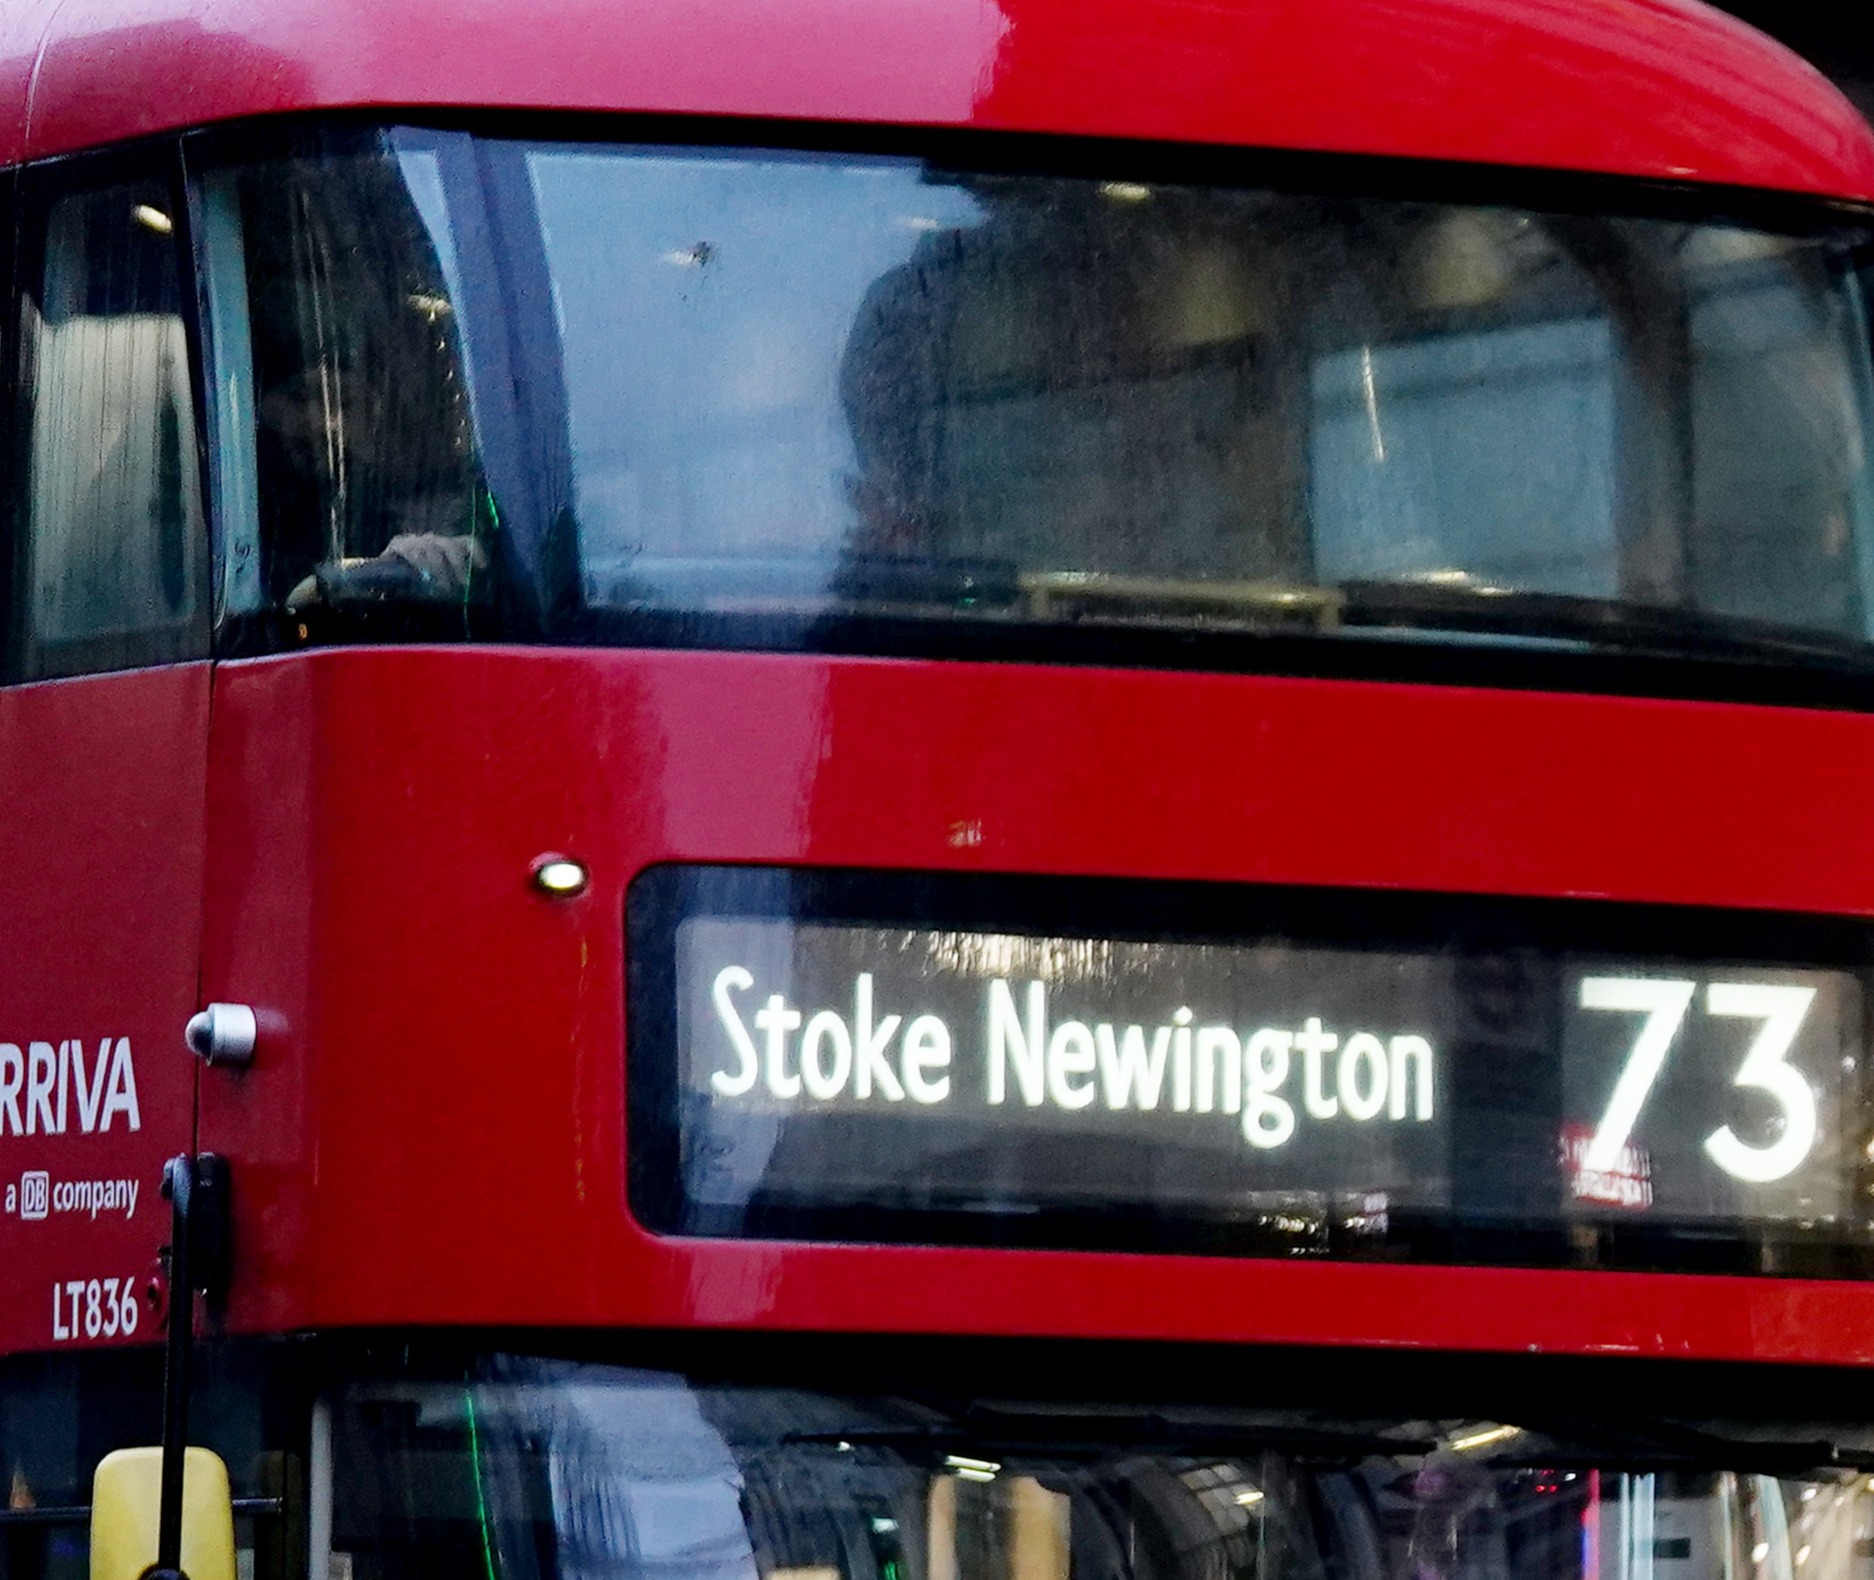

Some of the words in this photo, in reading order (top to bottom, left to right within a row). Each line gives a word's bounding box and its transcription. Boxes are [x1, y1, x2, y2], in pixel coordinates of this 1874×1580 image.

[712, 966, 951, 1103] Stoke
[989, 979, 1433, 1148] Newington
[1582, 979, 1817, 1182] 73
[5, 1183, 17, 1213] a
[23, 1175, 47, 1215] DB
[53, 1179, 139, 1219] company
[53, 1276, 138, 1340] LT836
